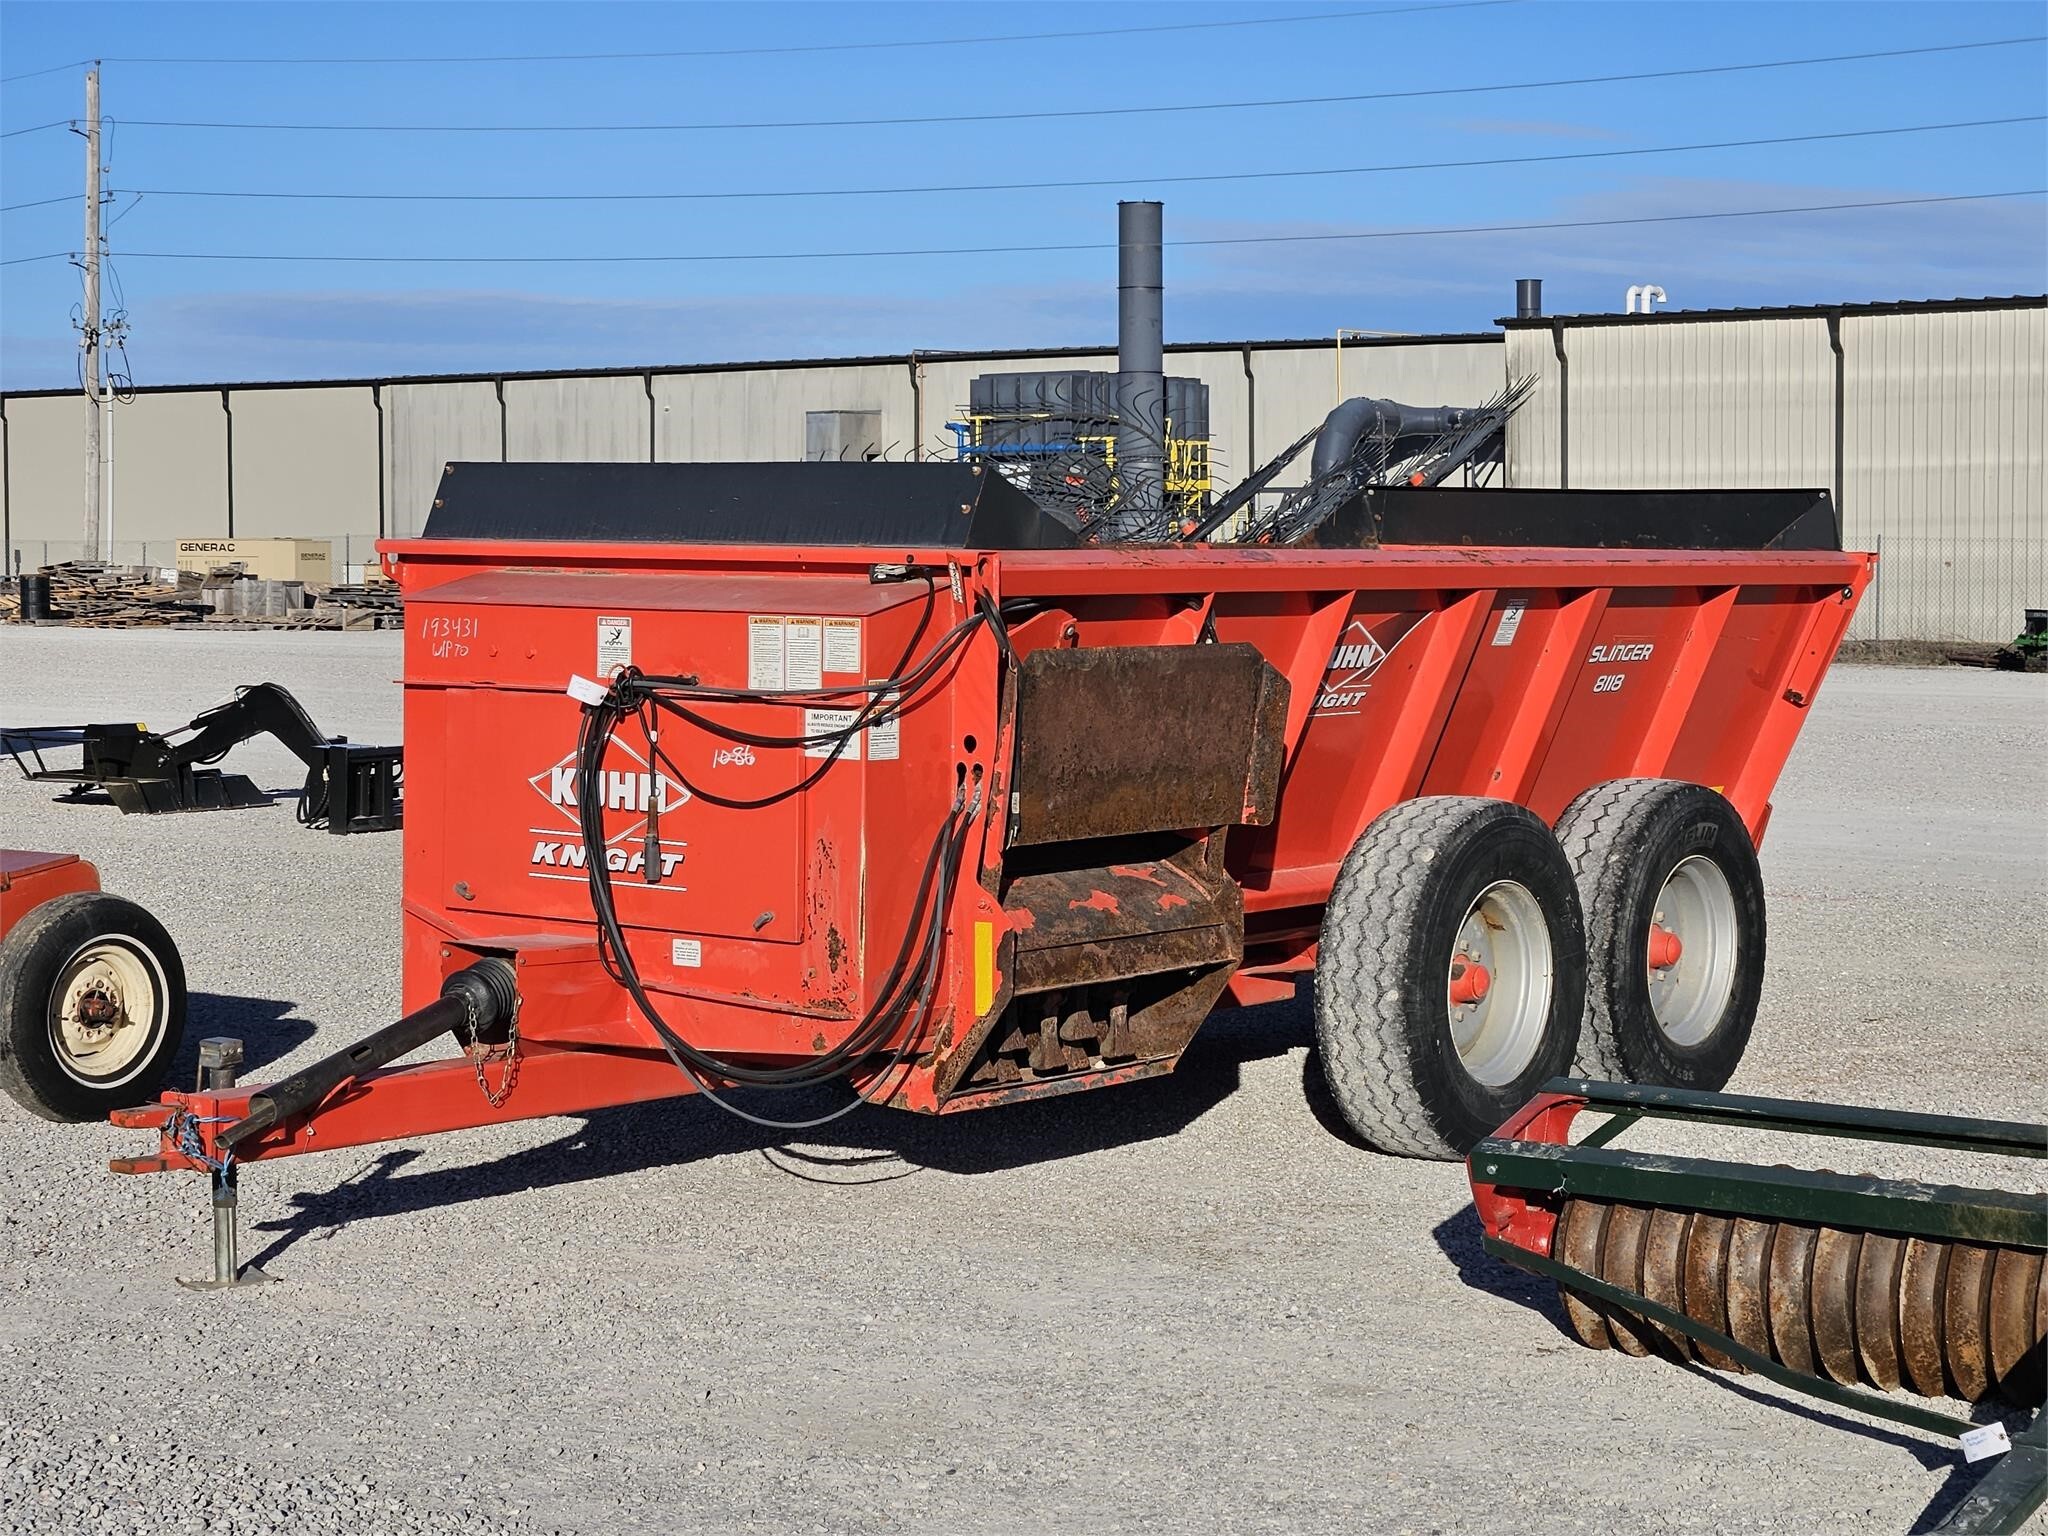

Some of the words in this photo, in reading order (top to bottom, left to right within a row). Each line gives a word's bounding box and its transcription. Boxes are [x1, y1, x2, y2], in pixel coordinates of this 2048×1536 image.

[180, 543, 235, 552] GENERAC
[422, 617, 478, 639] 193431
[1328, 644, 1377, 669] UHN
[1588, 644, 1654, 663] SLINGER
[1593, 674, 1625, 693] 8118
[1313, 692, 1367, 709] IGHT
[811, 713, 853, 722] IMPORTANT
[551, 767, 667, 813] KHN
[531, 841, 684, 876] KNGHT
